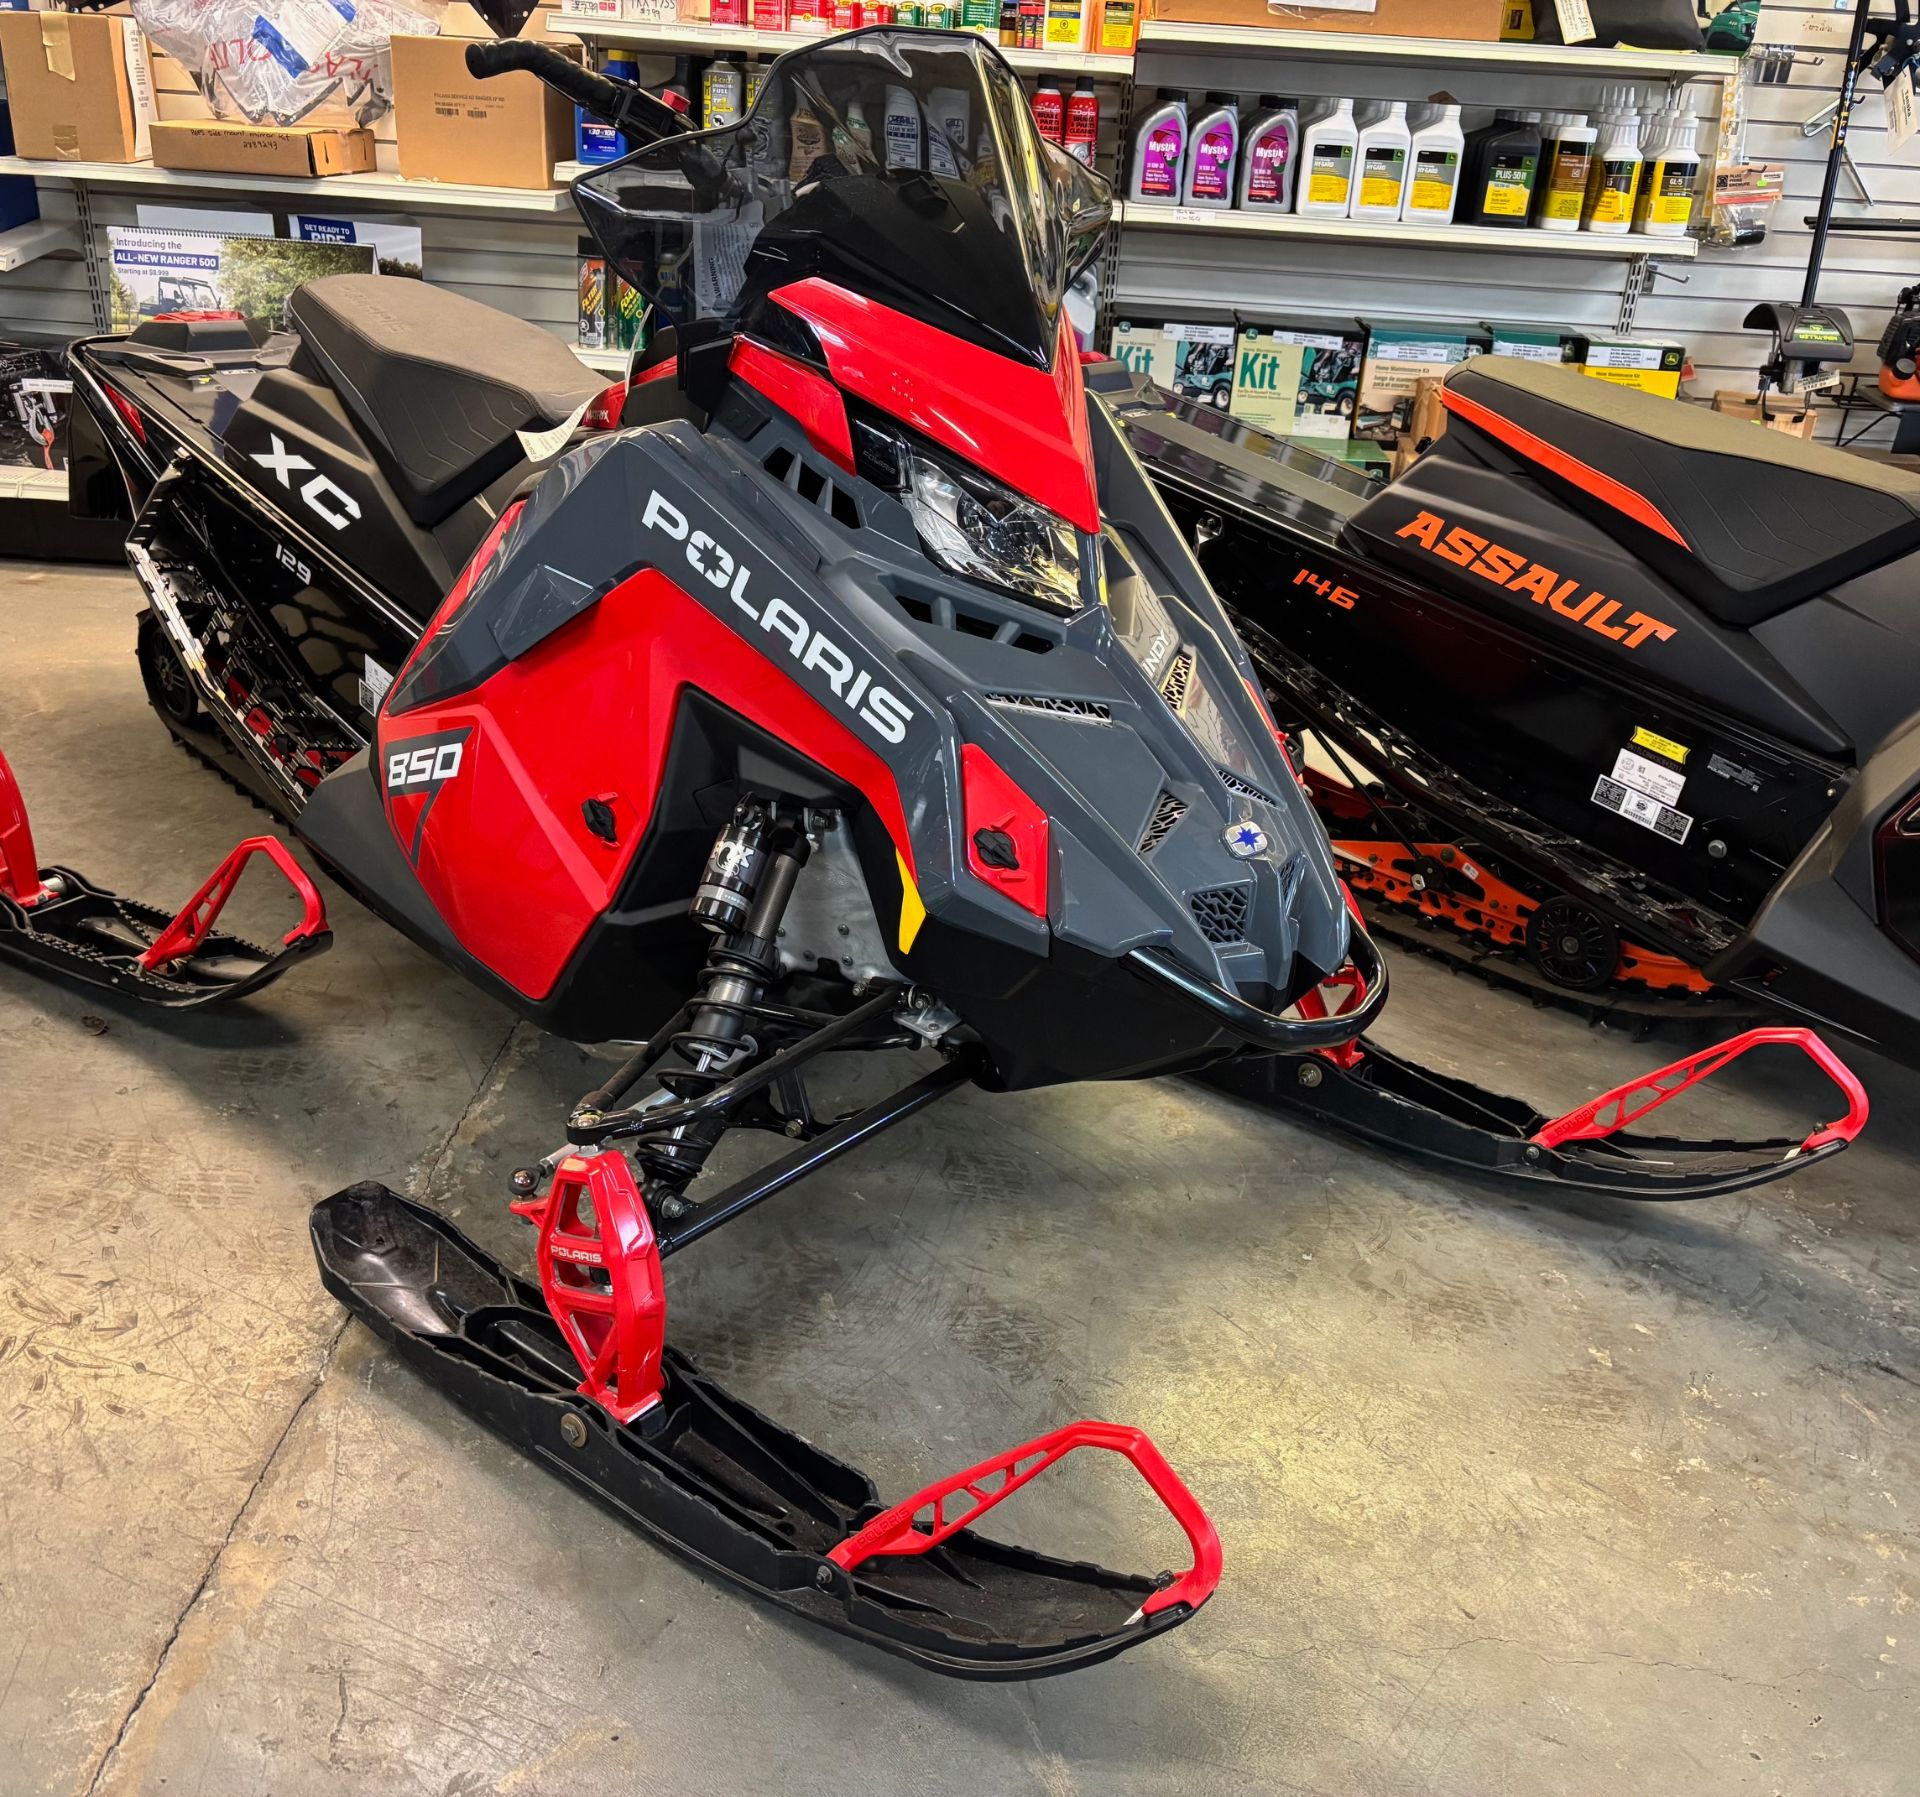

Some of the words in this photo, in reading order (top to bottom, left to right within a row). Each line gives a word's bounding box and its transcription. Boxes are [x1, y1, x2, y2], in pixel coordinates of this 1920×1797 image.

[1149, 141, 1177, 153] Mystik
[1200, 143, 1229, 155] Mystik
[1256, 147, 1284, 159] Mystik
[116, 237, 162, 251] Introducing
[163, 240, 182, 250] the
[304, 223, 319, 232] GET
[319, 225, 340, 234] READY
[341, 227, 351, 235] TO
[116, 253, 159, 265] ALL-NEW
[160, 256, 198, 267] RANGER
[199, 257, 217, 268] 500
[117, 267, 141, 276] Starting
[1115, 345, 1155, 376] Kit
[1238, 351, 1281, 391] Kit
[248, 431, 363, 531] XC
[275, 543, 312, 586] 129
[1395, 509, 1678, 650] ASSAULT
[1291, 568, 1361, 611] 146
[641, 489, 915, 744] POLARIS
[1141, 629, 1171, 678] INDY
[387, 742, 463, 788] 850
[1555, 1102, 1600, 1137] POLARIS
[550, 1245, 602, 1264] POLARIS
[855, 1507, 910, 1550] POLARIS
